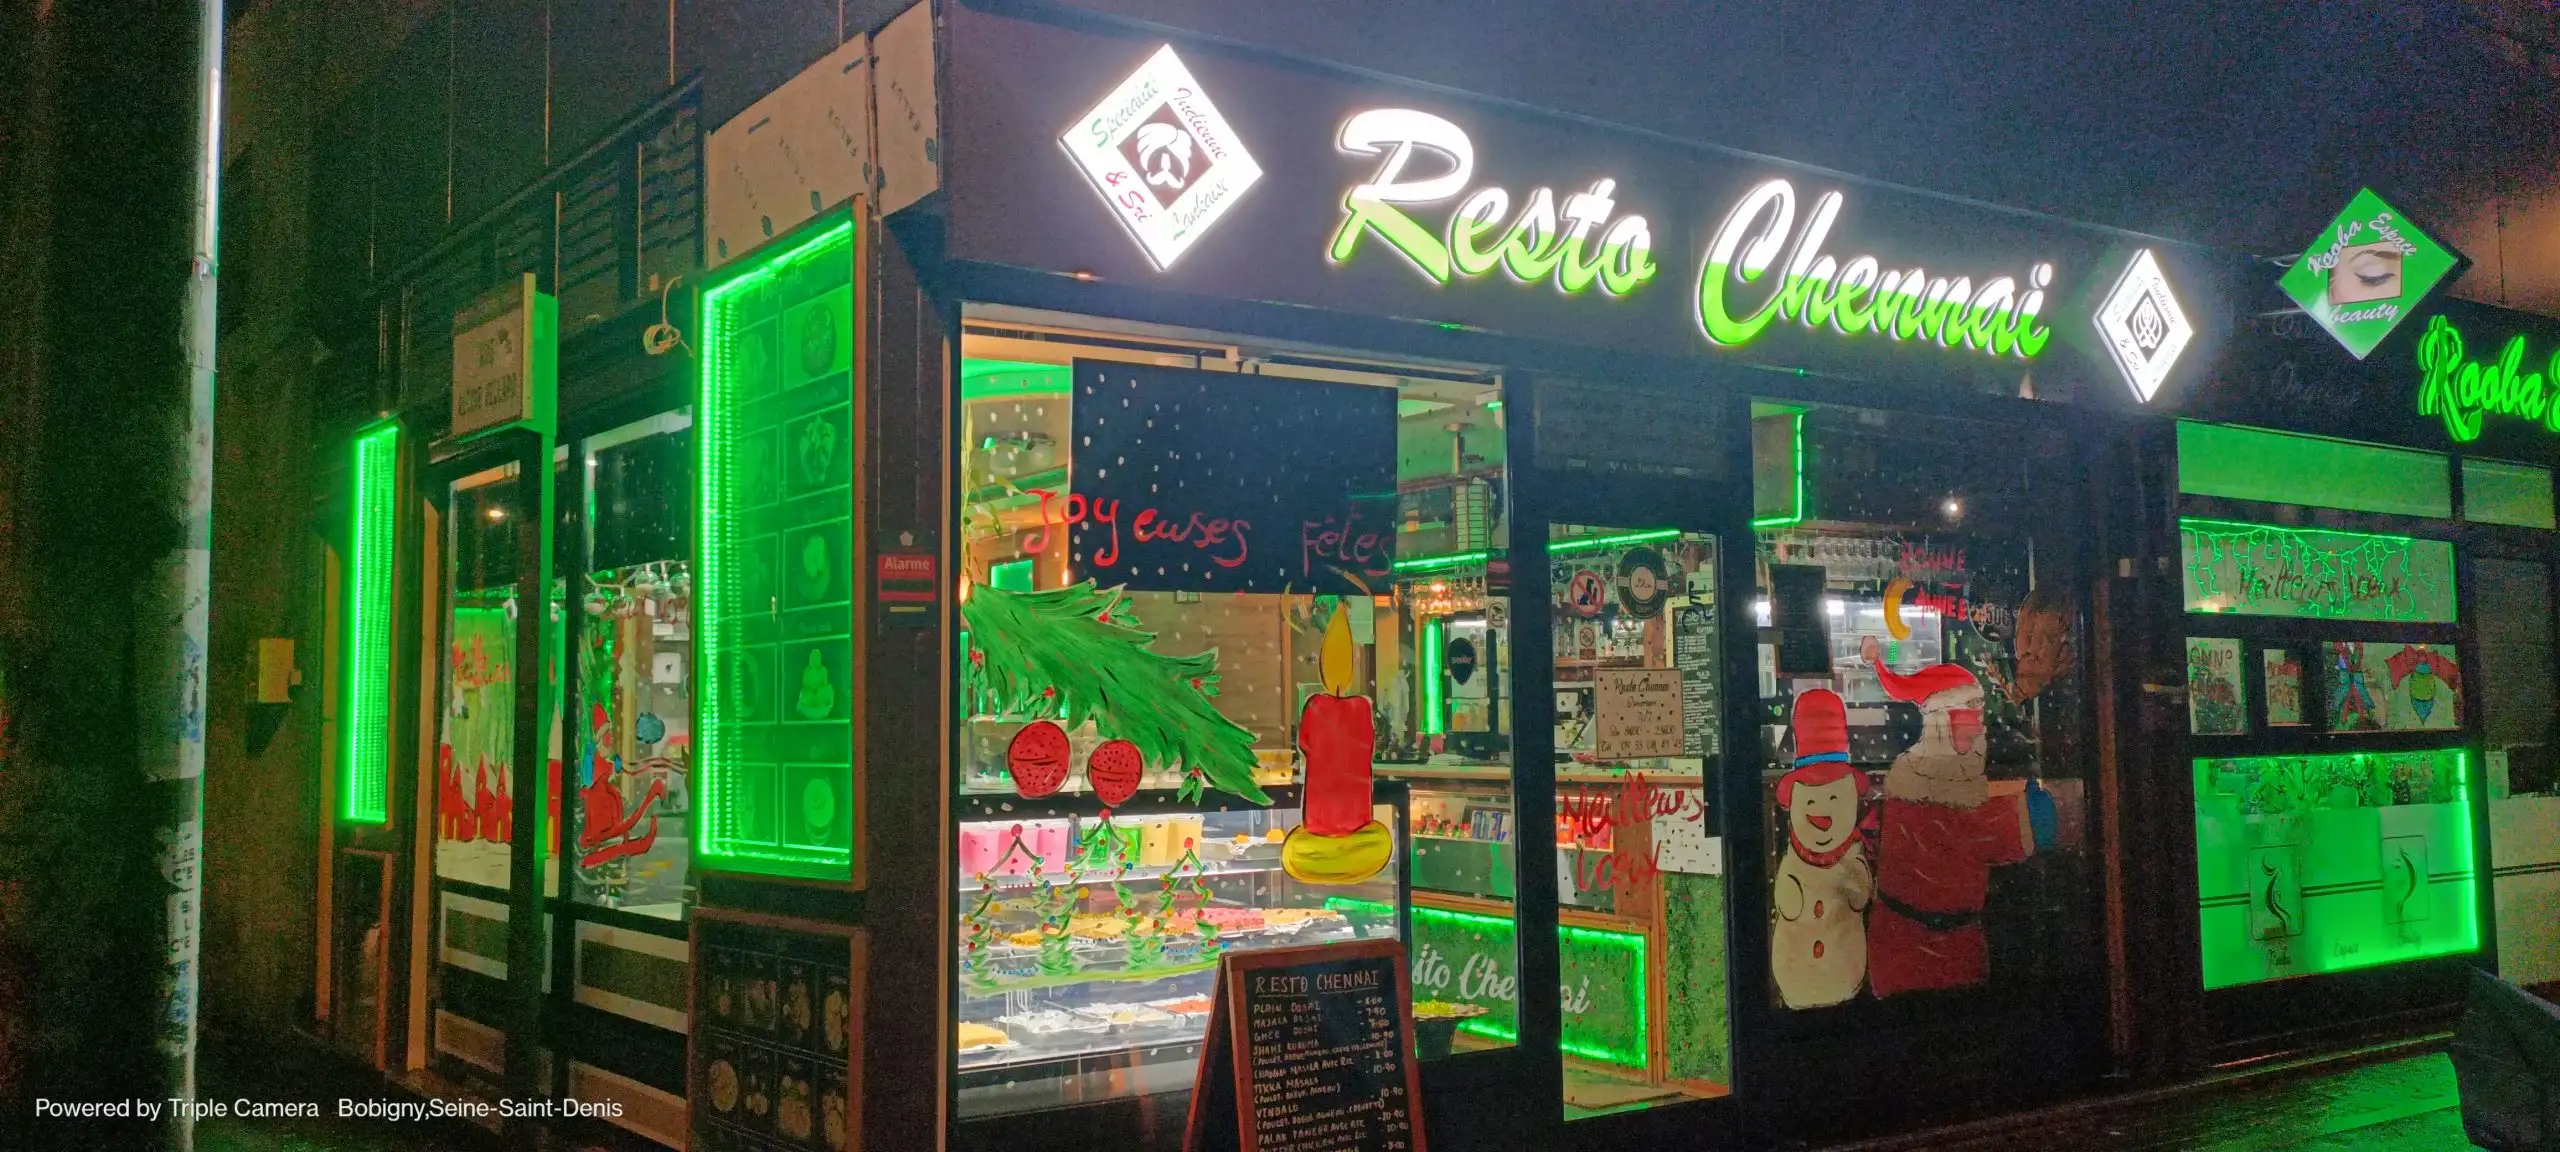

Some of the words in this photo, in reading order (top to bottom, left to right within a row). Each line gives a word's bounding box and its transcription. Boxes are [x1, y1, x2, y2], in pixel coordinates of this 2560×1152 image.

[1118, 190, 1153, 223] Sri
[1326, 107, 1657, 297] Resto
[1694, 178, 2054, 358] Chennai
[2368, 212, 2417, 256] Espace
[2308, 221, 2362, 277] Rooba
[2329, 303, 2399, 325] beauty
[2417, 314, 2546, 442] Rooba
[884, 556, 930, 570] Alarme
[1256, 976, 1308, 993] RESTO
[1317, 970, 1379, 990] CHENNAI
[1253, 1003, 1282, 1014] PLAIN
[1253, 1015, 1288, 1028] MASALA
[1254, 1030, 1280, 1042] GHEE
[1254, 1083, 1281, 1094] TIKKA
